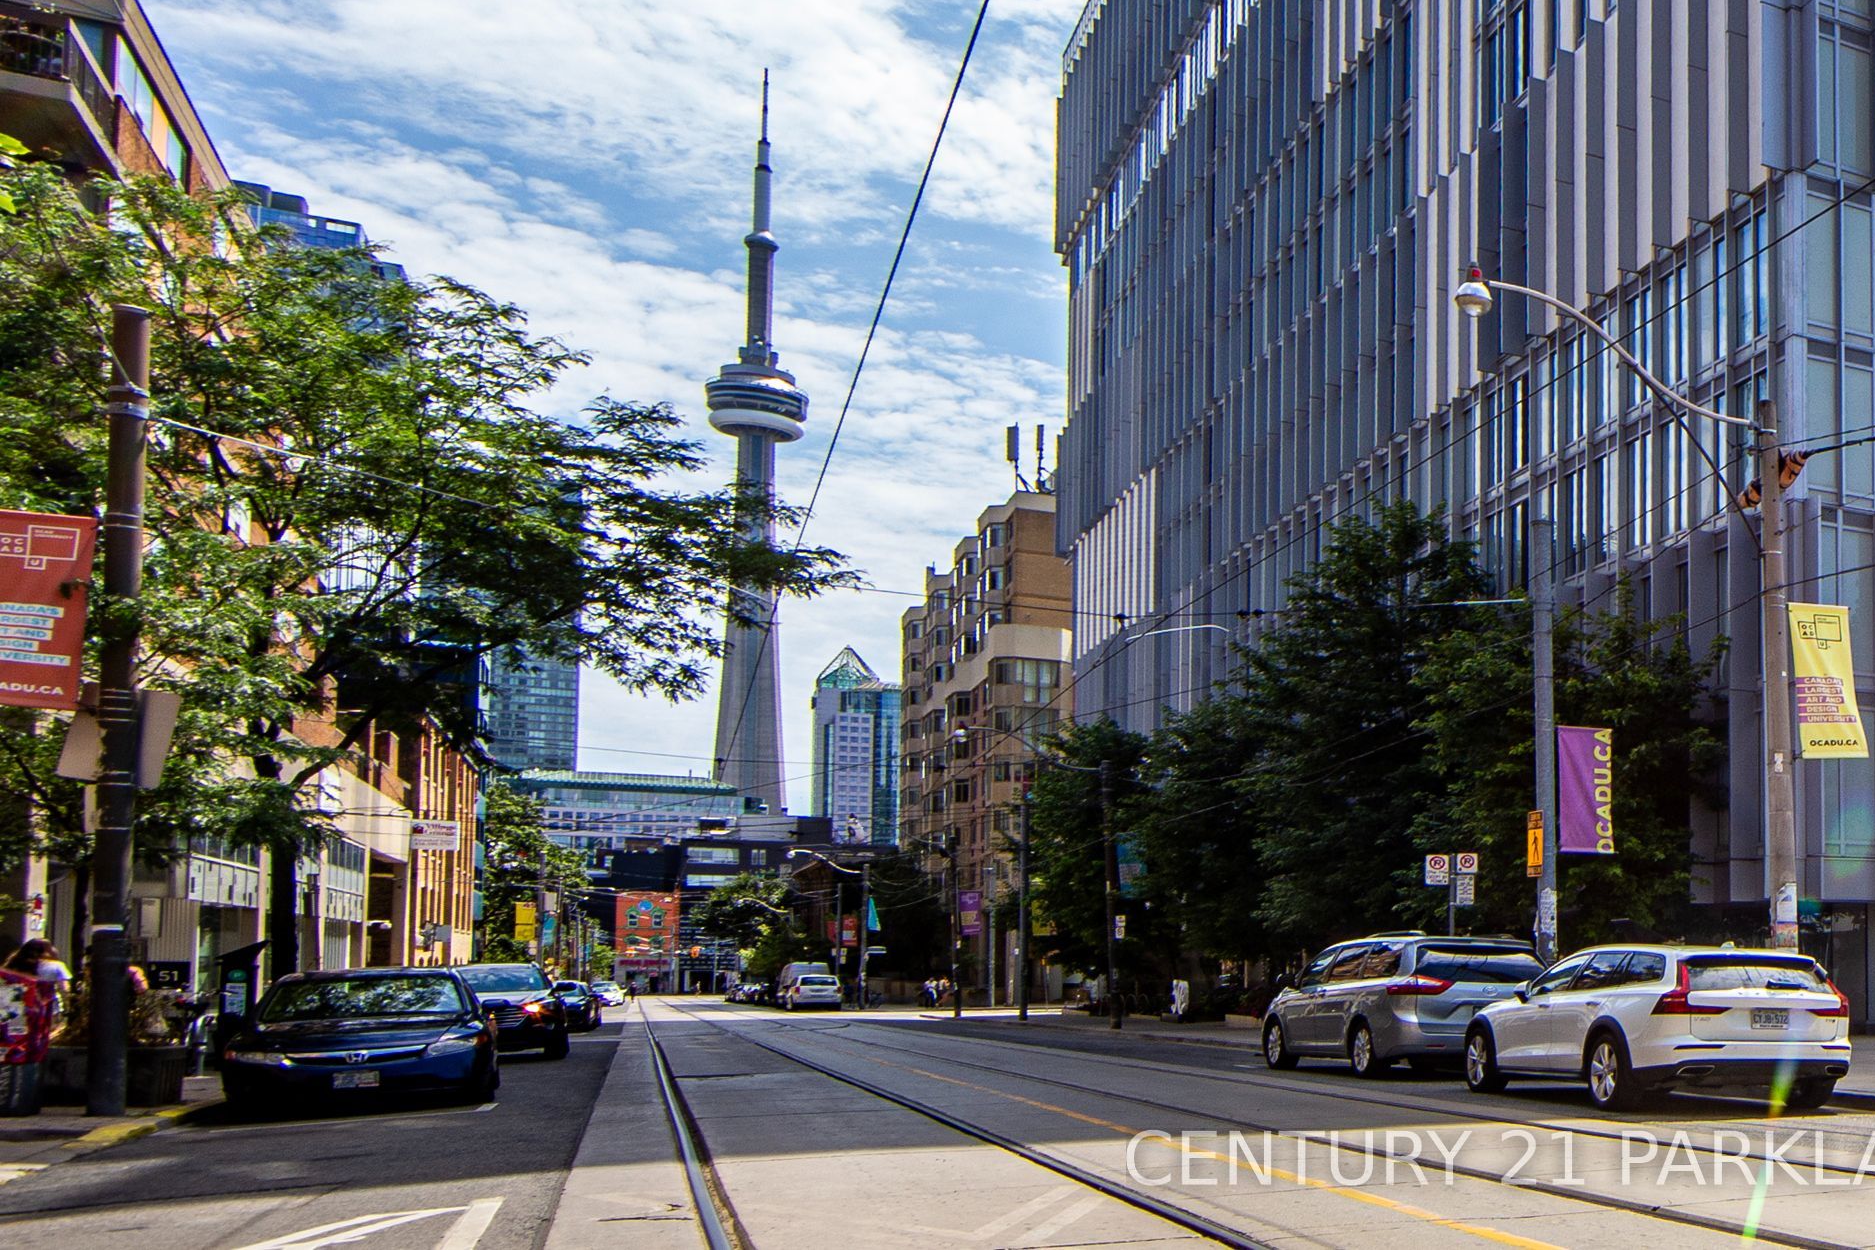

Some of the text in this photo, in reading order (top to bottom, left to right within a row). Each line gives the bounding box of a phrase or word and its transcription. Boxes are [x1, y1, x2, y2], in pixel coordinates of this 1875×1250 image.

[15, 628, 47, 639] AND
[1805, 686, 1842, 694] LARGEST
[1807, 705, 1838, 713] DESIGN
[1807, 715, 1856, 723] UNIVERSITY
[1809, 738, 1859, 747] OCADU.CA
[1593, 728, 1615, 854] OCADU.CA
[158, 970, 179, 982] 51
